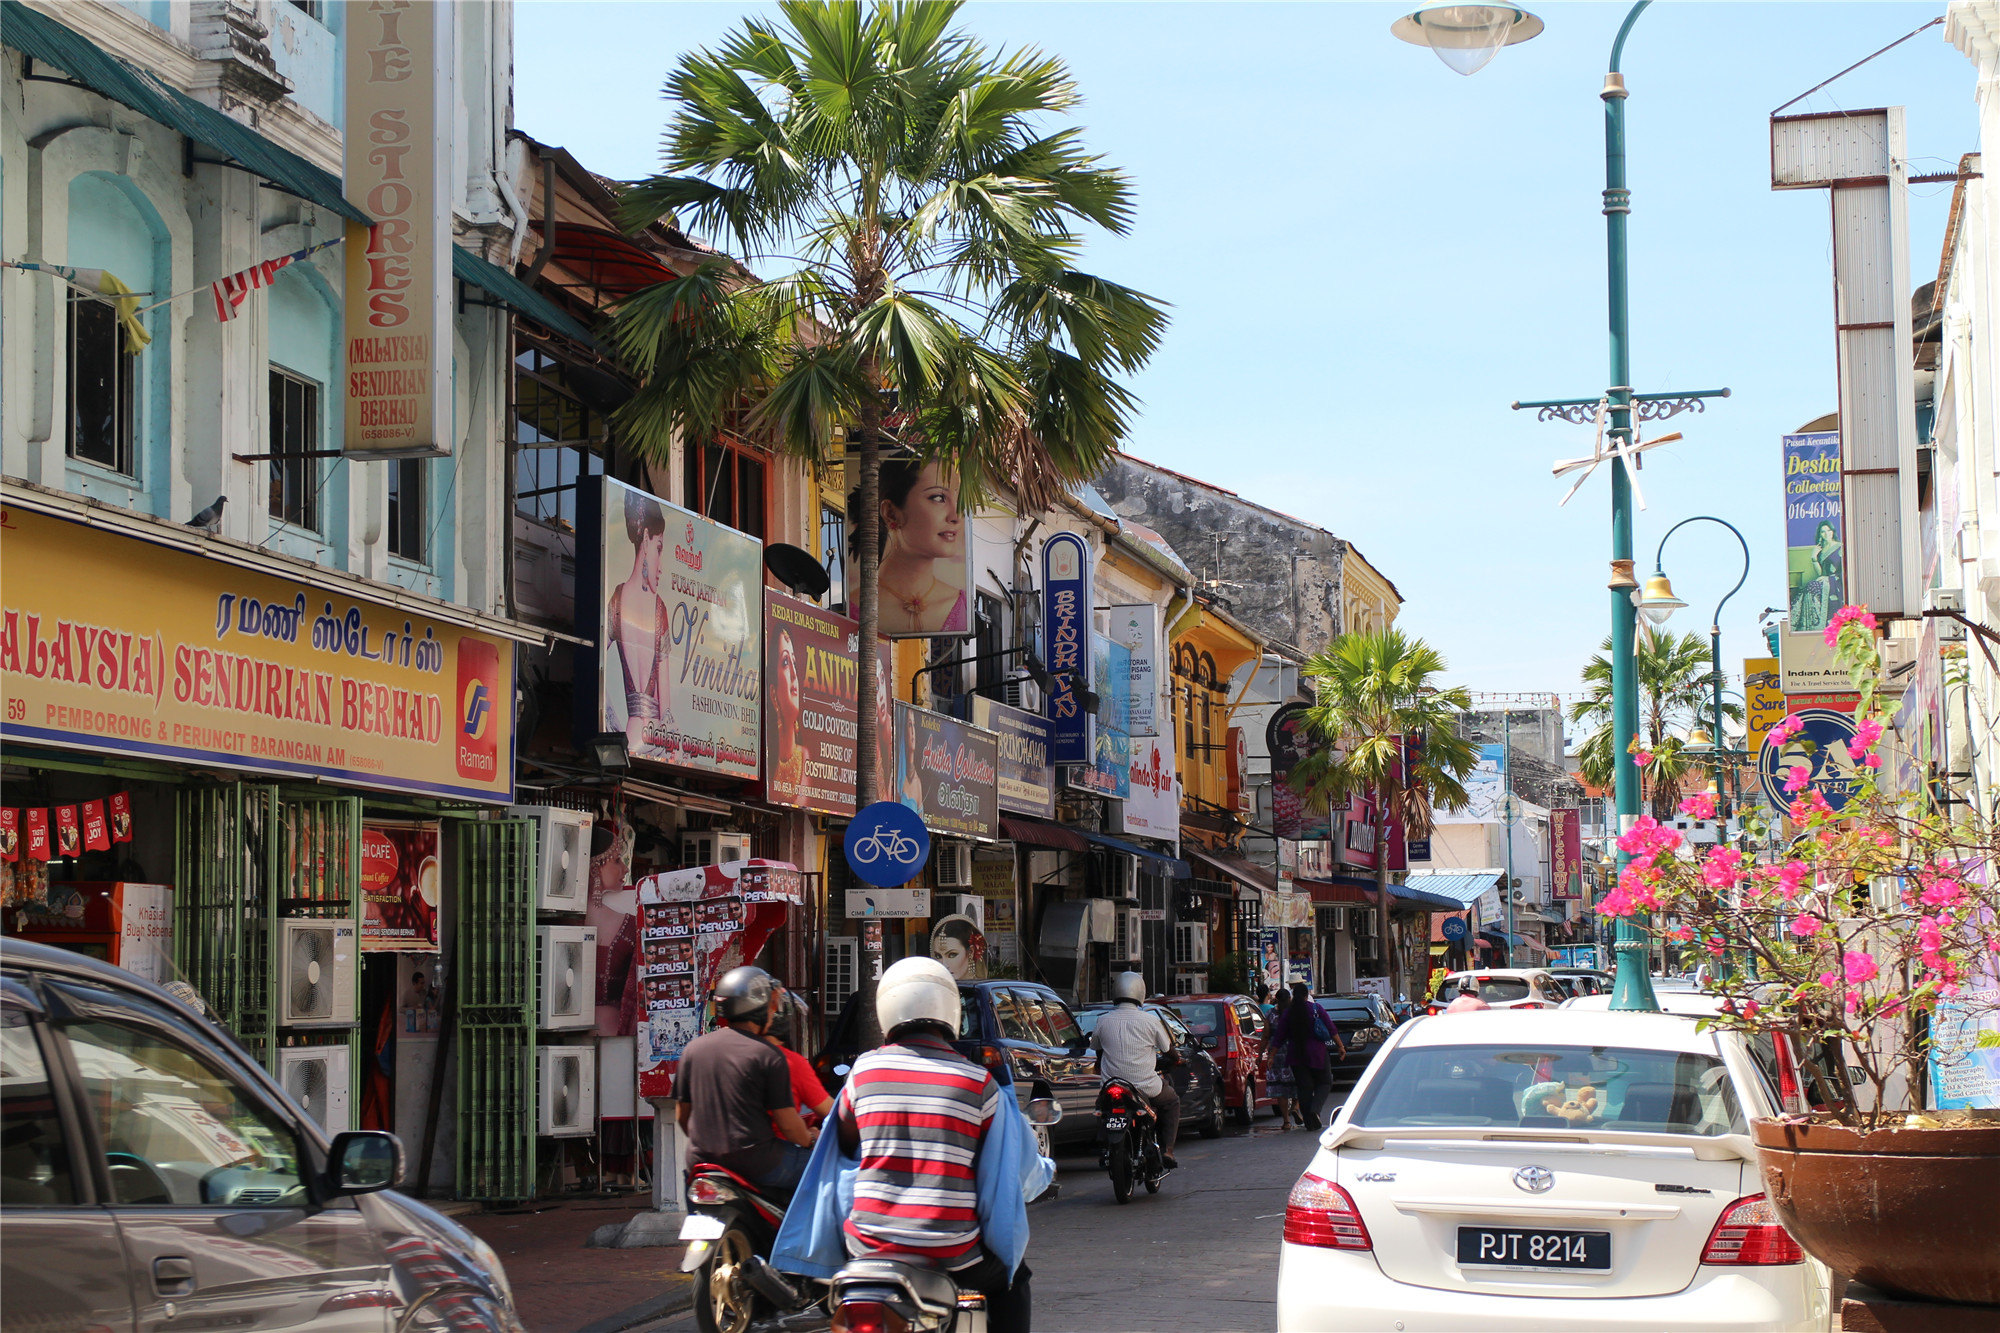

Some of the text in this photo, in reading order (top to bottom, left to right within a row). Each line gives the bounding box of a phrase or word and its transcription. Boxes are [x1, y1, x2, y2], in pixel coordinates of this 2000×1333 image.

[368, 109, 414, 328] STORES
[350, 333, 429, 368] (MALAYSIA)
[350, 368, 427, 397] SENDIRIAN
[360, 399, 418, 426] BERHAD
[361, 427, 415, 440] (658086-V)
[1786, 438, 1806, 447] Pusat
[1788, 501, 1825, 519] 016-461
[771, 603, 840, 639] KEDAI EMAS TIRUAN
[672, 602, 759, 701] Vinitha
[1053, 590, 1078, 718] BRINDHVAN
[174, 645, 332, 726] SENDIRIAN
[341, 678, 442, 744] BERHAD
[8, 698, 26, 720] 59
[692, 695, 758, 725] FASHION SDN. BHD.
[803, 710, 825, 732] GOLD
[921, 714, 941, 732] Koleksi
[46, 703, 384, 771] PEMBORONG & PERUNCIT BARANGAN AM (658086-V)
[460, 746, 493, 771] Ramani
[820, 742, 843, 762] HOUSE
[921, 734, 952, 776] Anitha
[1776, 738, 1860, 781] 5A
[804, 760, 839, 781] COSTUME
[1161, 769, 1172, 792] air
[32, 836, 44, 848] JOY
[89, 827, 102, 840] JOY
[1551, 811, 1567, 897] WELCOME
[363, 893, 402, 903] SATISFACTION
[139, 907, 166, 921] Khasiat
[126, 923, 145, 937] Buah
[340, 928, 353, 936] YORK
[648, 925, 689, 938] PERUSU
[698, 920, 739, 933] PERUSU
[649, 962, 689, 974] PERUSU
[650, 998, 690, 1010] PERUSU
[1944, 1066, 1985, 1076] Photography
[1945, 1073, 1985, 1083] Videography
[1965, 1088, 1992, 1096] Catering
[1480, 1233, 1587, 1262] PJT 8214
